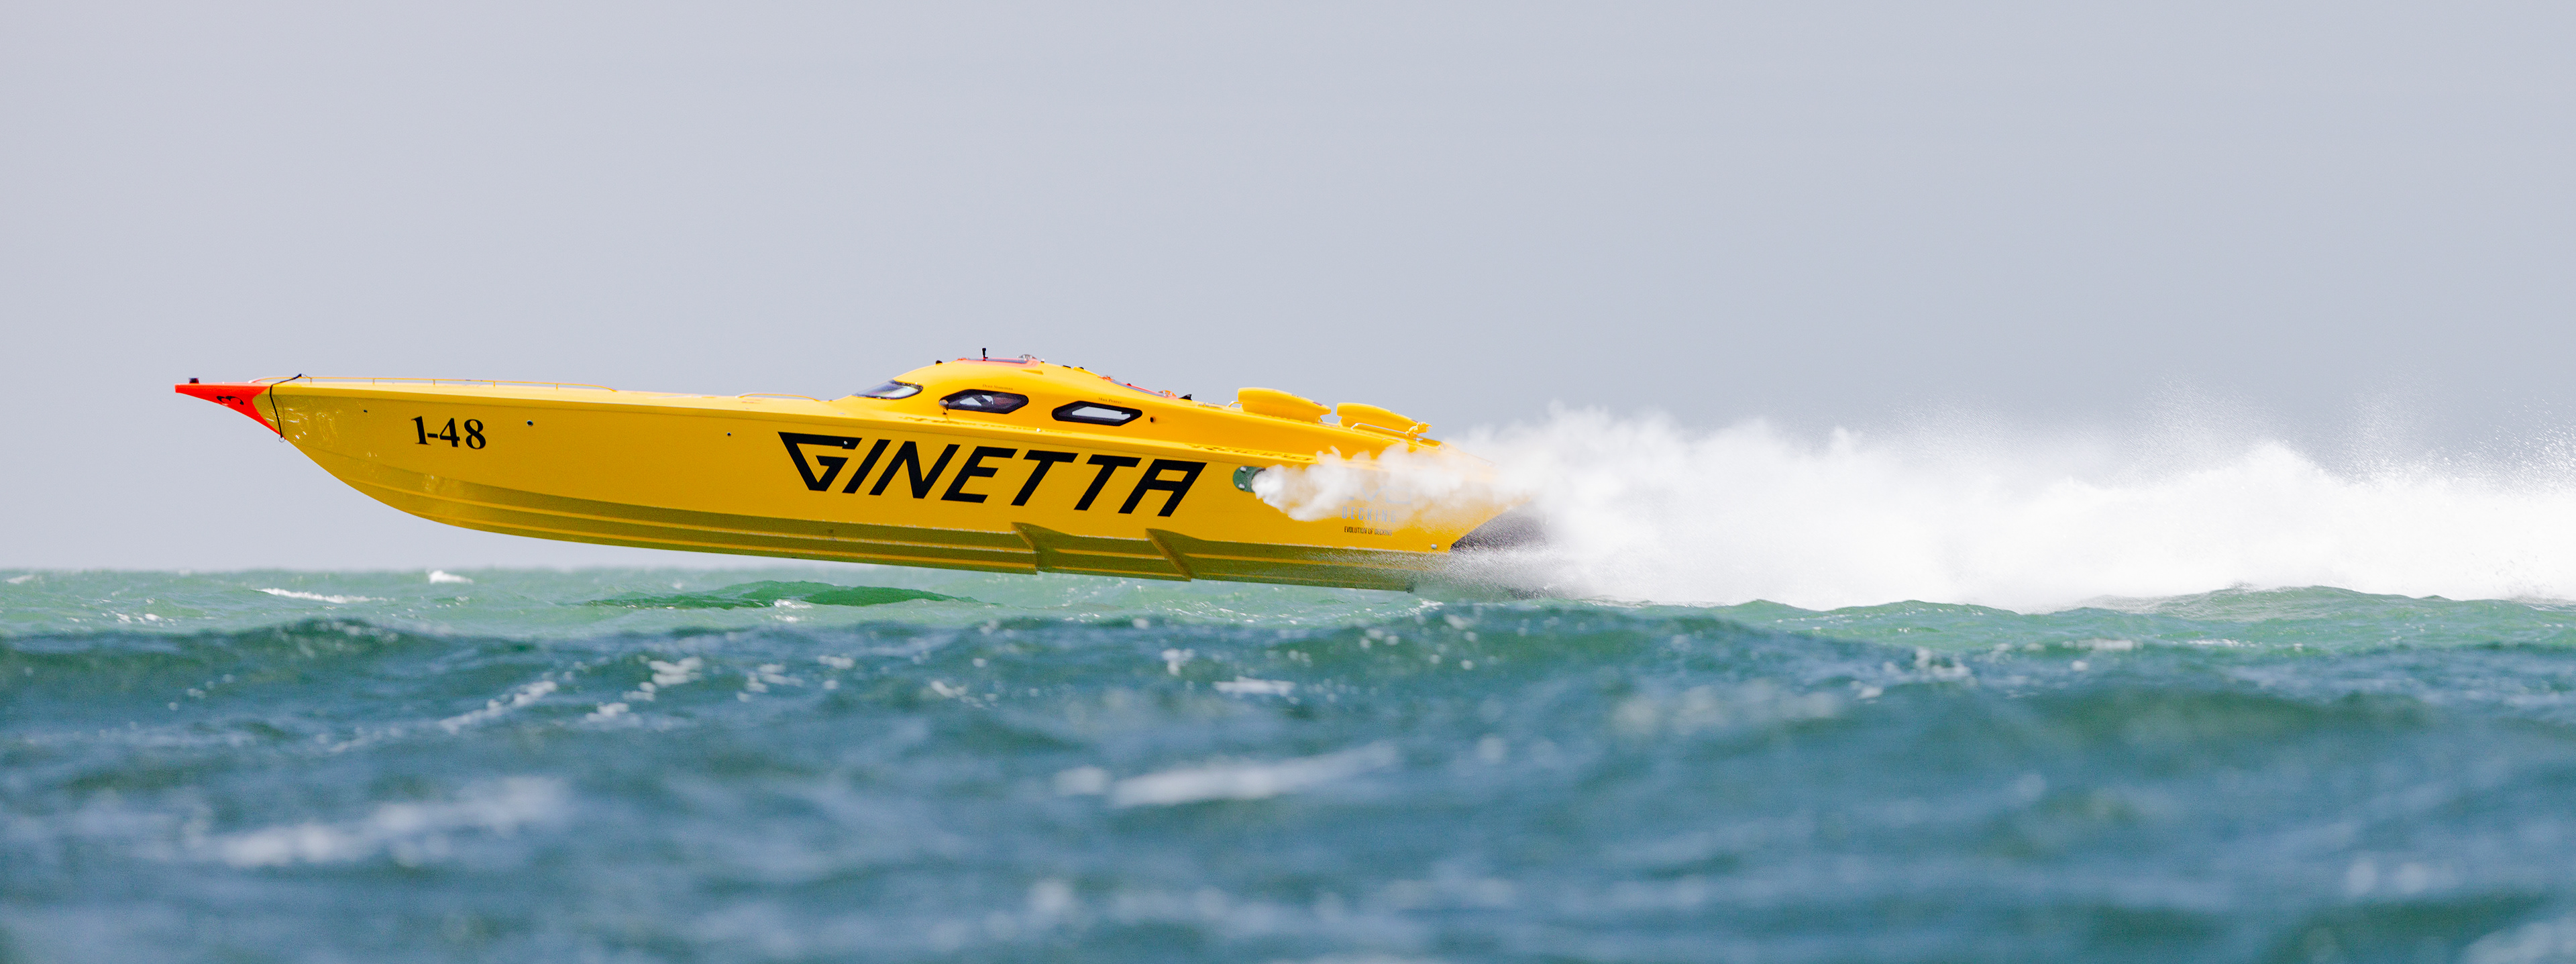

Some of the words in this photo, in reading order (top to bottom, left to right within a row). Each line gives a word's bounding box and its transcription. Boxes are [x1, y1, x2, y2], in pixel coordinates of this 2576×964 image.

[411, 415, 486, 449] 1-48
[777, 431, 1208, 517] GINETTA
[1342, 506, 1396, 523] DECKING
[1344, 526, 1367, 535] EVOLUTION
